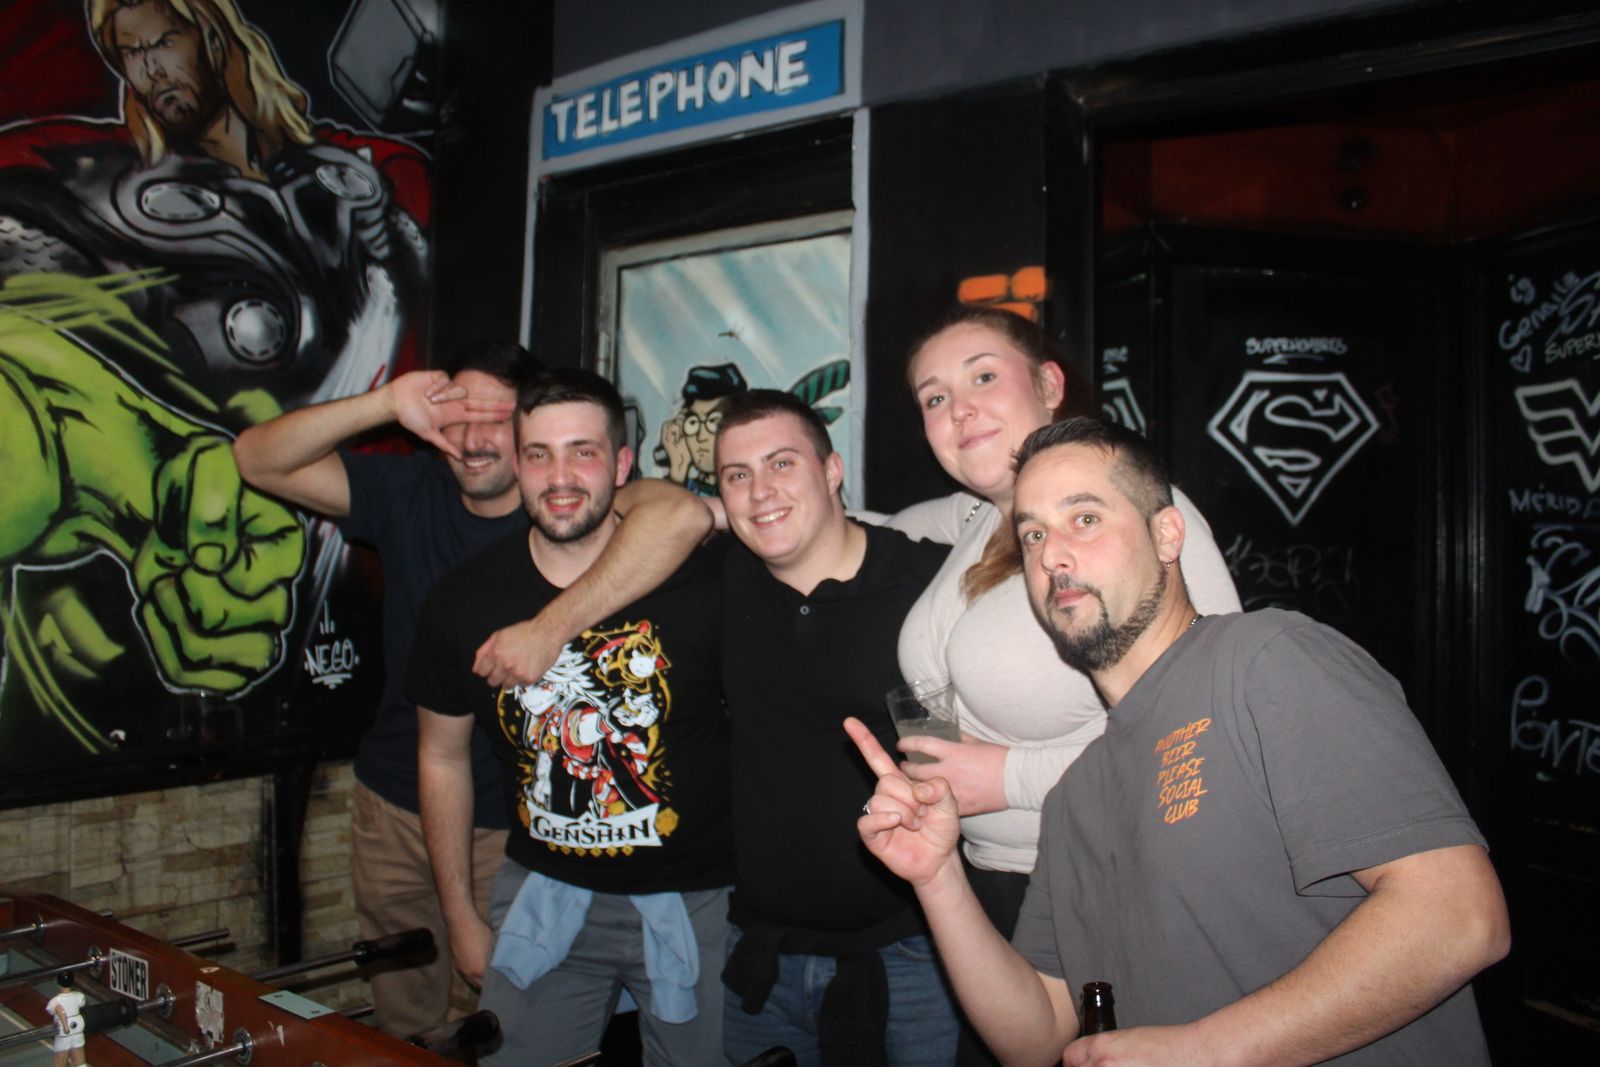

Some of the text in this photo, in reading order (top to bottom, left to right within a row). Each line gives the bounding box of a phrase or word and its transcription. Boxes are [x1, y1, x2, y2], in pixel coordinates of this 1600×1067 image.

[550, 40, 809, 143] TELEPHONE
[1544, 332, 1600, 364] SUPER
[1154, 718, 1211, 755] ANOTHER
[1161, 740, 1197, 768] BEER
[1156, 757, 1205, 788] PLEASE
[1159, 777, 1209, 808] SOCIAL
[1164, 799, 1200, 824] CLUB
[532, 815, 651, 845] GENSHIN
[111, 952, 148, 1000] STONER
